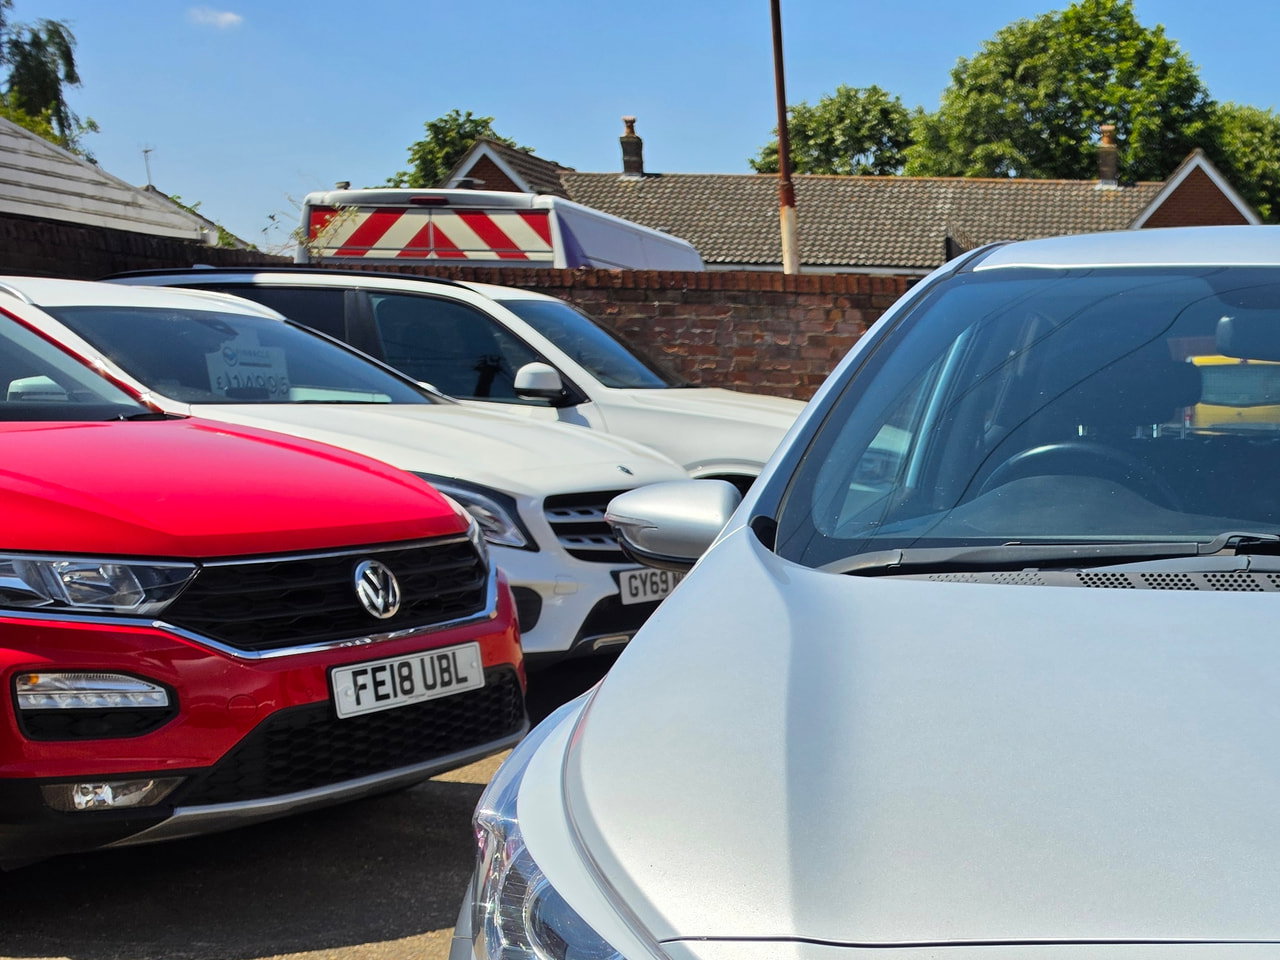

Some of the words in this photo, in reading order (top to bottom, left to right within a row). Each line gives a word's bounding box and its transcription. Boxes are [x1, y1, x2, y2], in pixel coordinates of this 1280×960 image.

[628, 571, 669, 598] GY69
[351, 661, 415, 706] FE18
[420, 651, 468, 692] UBL
